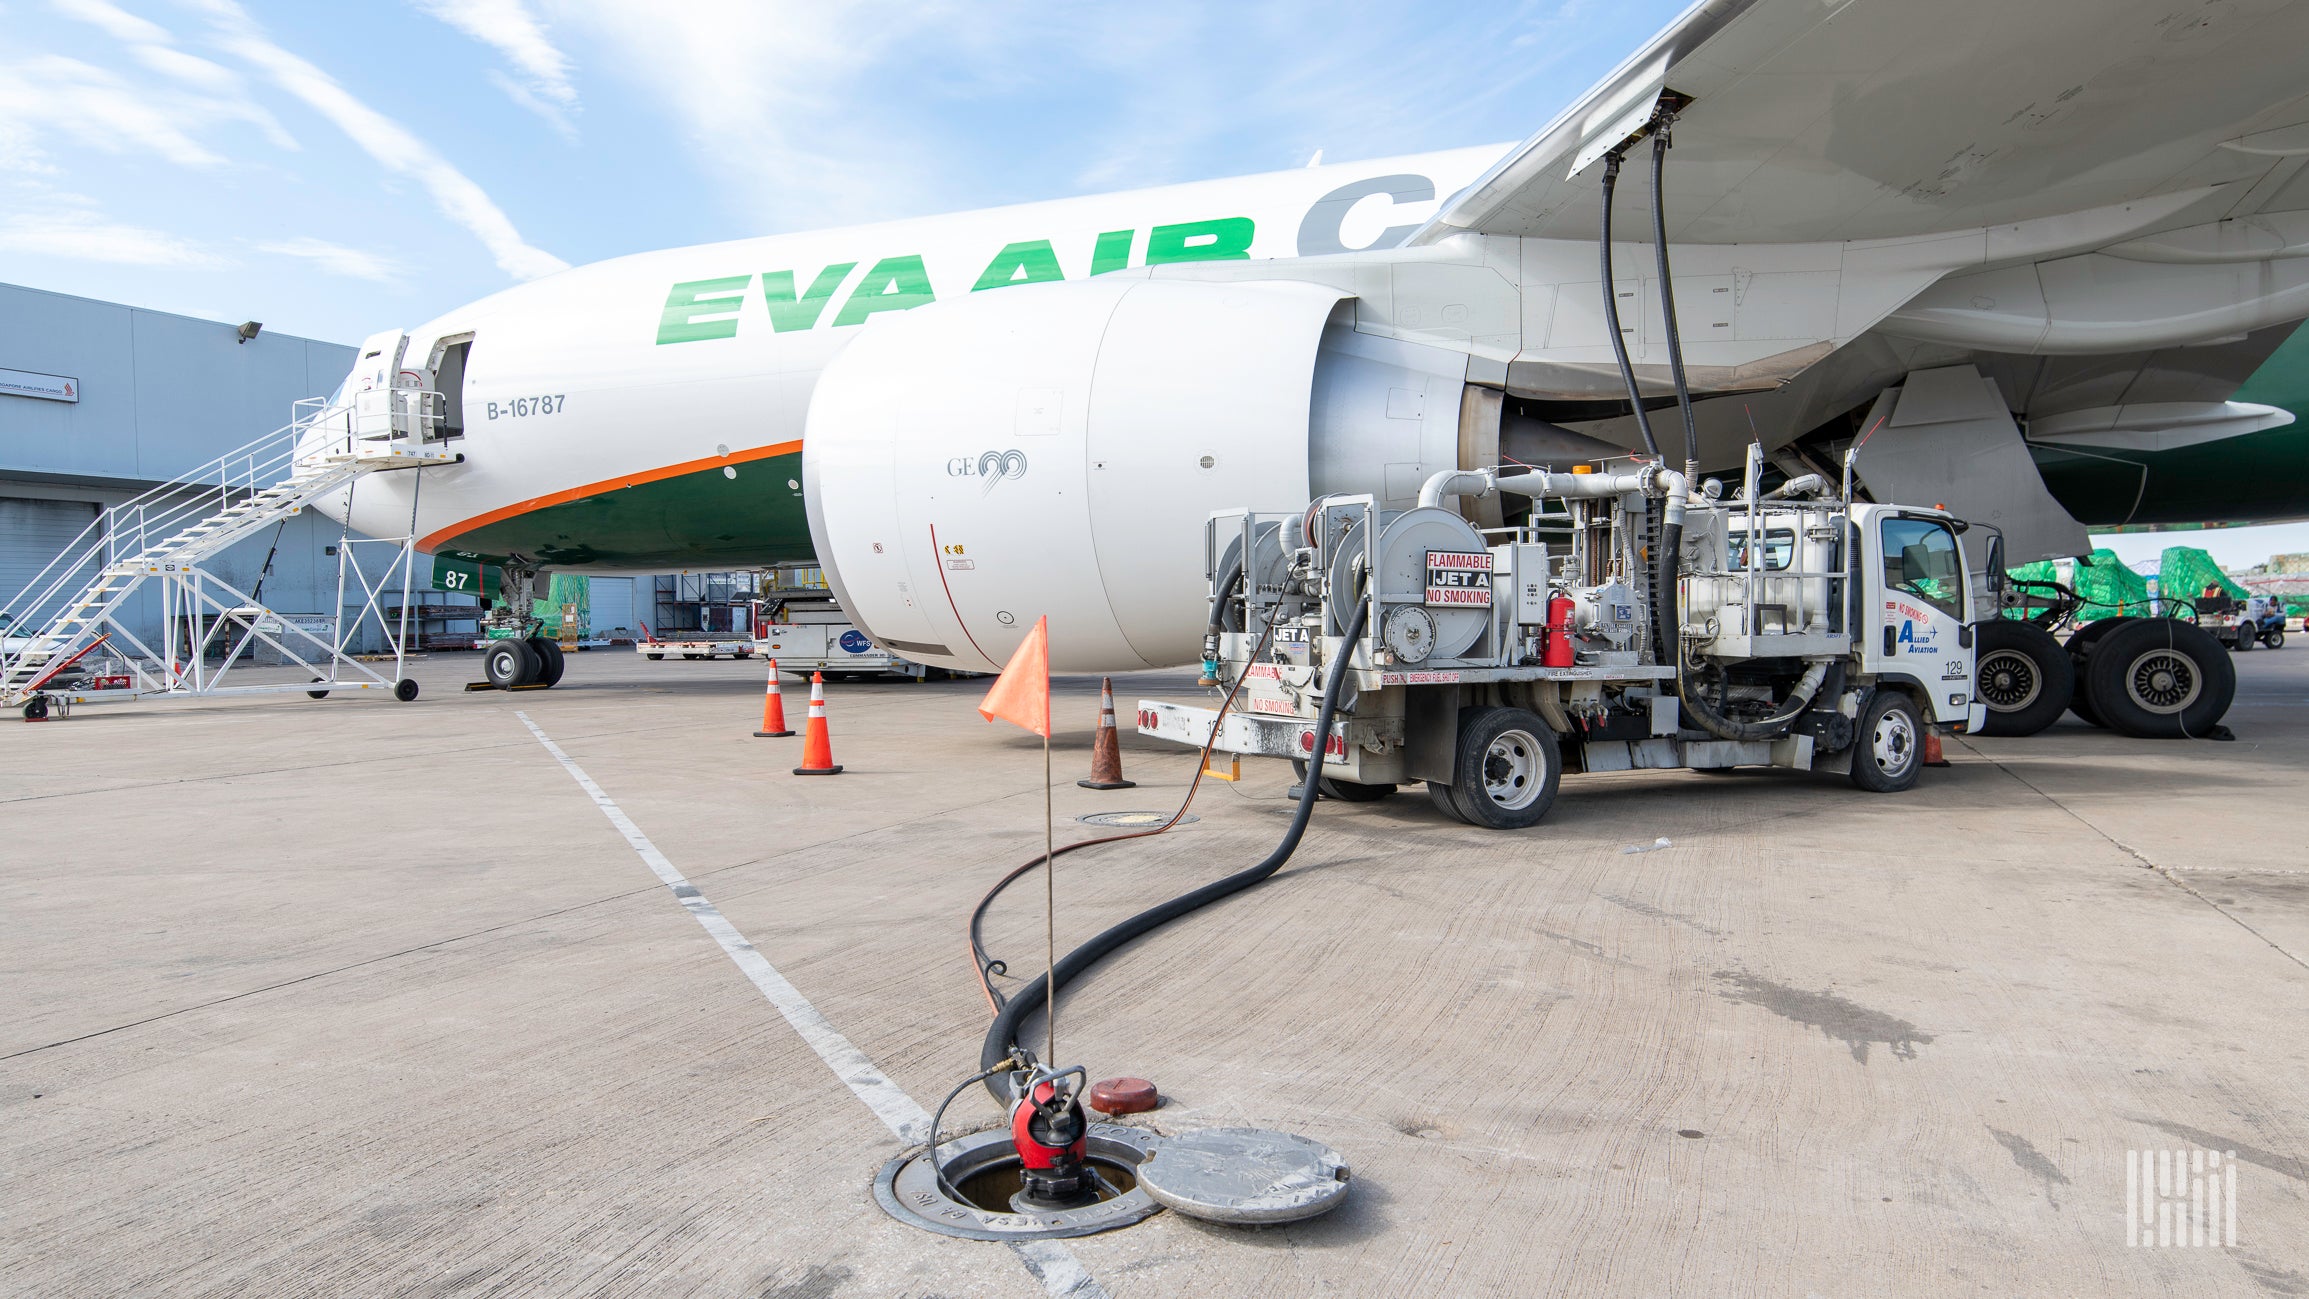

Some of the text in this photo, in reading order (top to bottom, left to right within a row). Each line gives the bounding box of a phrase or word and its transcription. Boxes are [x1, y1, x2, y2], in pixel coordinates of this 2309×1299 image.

[655, 254, 937, 346] EVA
[487, 394, 566, 420] B-16787
[1428, 554, 1491, 569] FLAMMABLE
[445, 570, 469, 590] 87
[1435, 571, 1489, 587] JET A
[1426, 589, 1490, 604] NO SMOKING
[1899, 602, 1905, 613] NO
[1905, 605, 1923, 622] SMOKING
[1275, 629, 1310, 642] JET A
[1897, 619, 1930, 644] ALLIED
[1908, 644, 1938, 654] AVIATION
[1945, 660, 1963, 675] 129
[1382, 674, 1399, 684] PUSH
[1409, 673, 1431, 683] EMERGENCY
[1432, 673, 1441, 682] FUEL
[1442, 672, 1451, 682] SHUT
[1254, 698, 1295, 715] NO SMOKING
